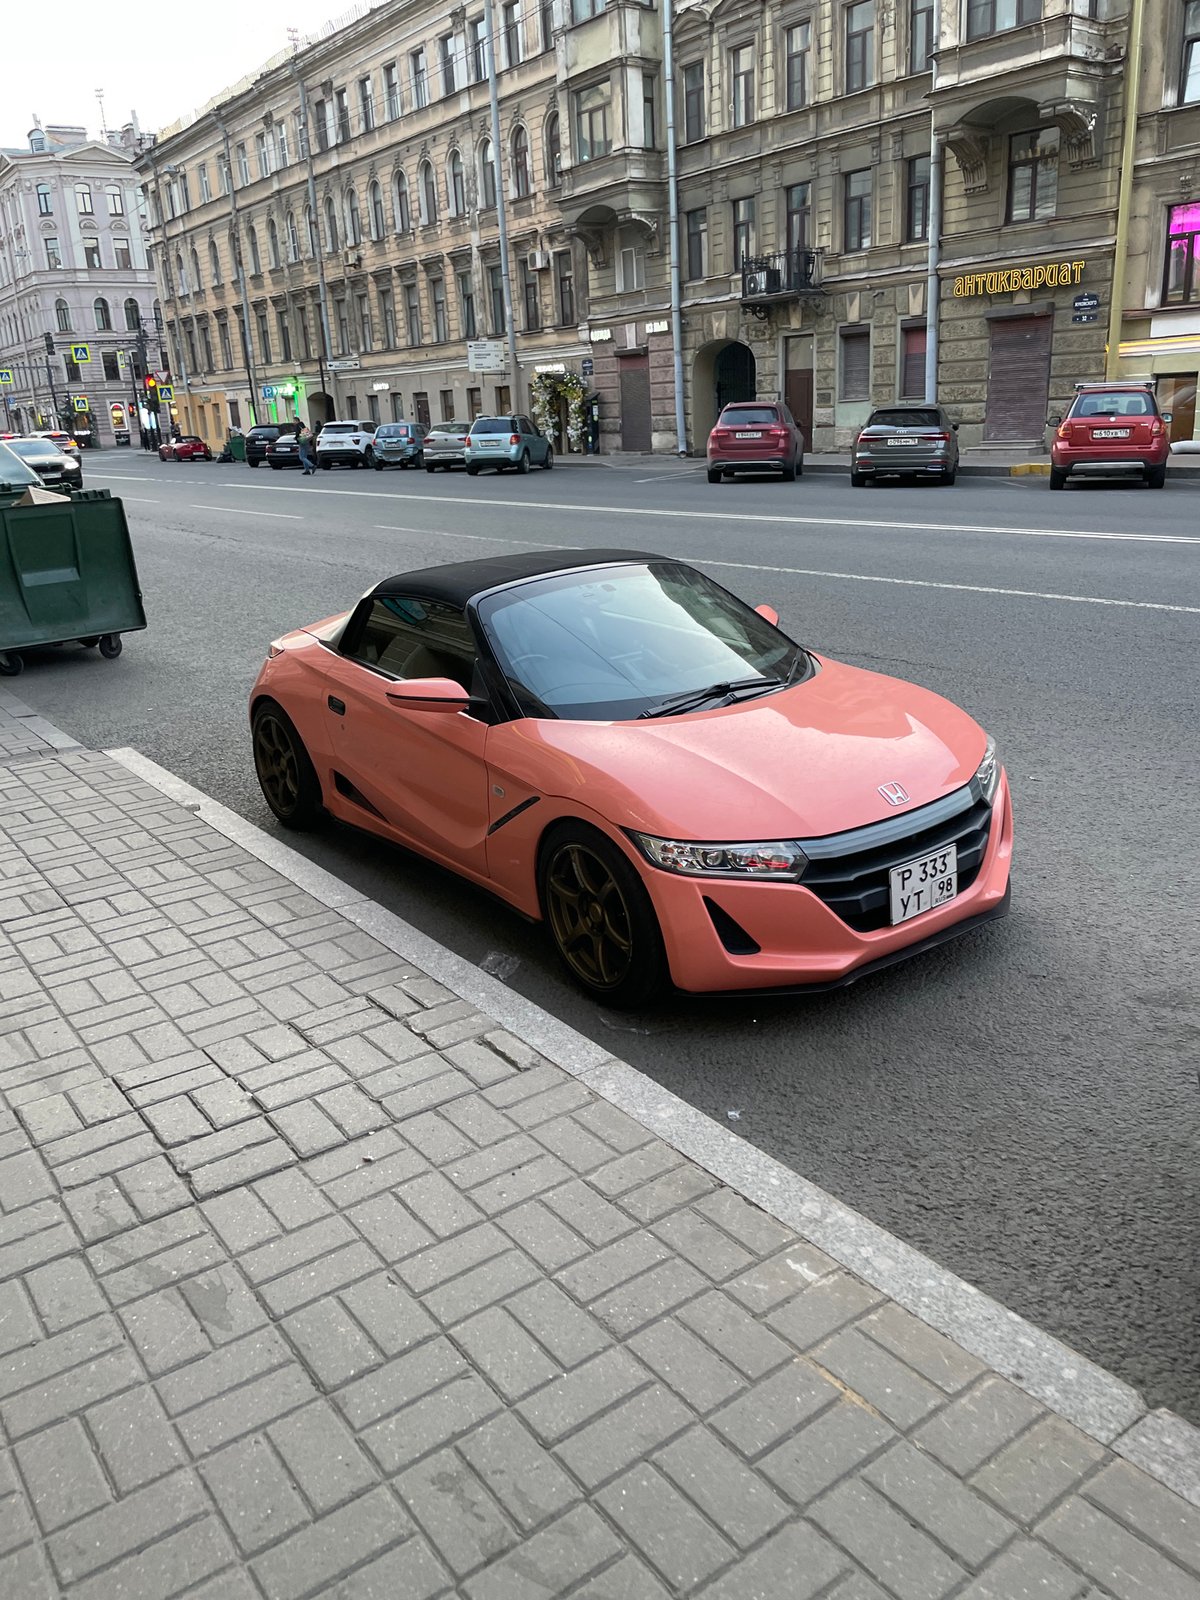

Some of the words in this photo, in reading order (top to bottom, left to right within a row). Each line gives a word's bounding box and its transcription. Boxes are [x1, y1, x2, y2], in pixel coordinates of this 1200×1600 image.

[919, 854, 948, 882] 333
[938, 877, 953, 896] 98
[901, 890, 923, 917] УТ
